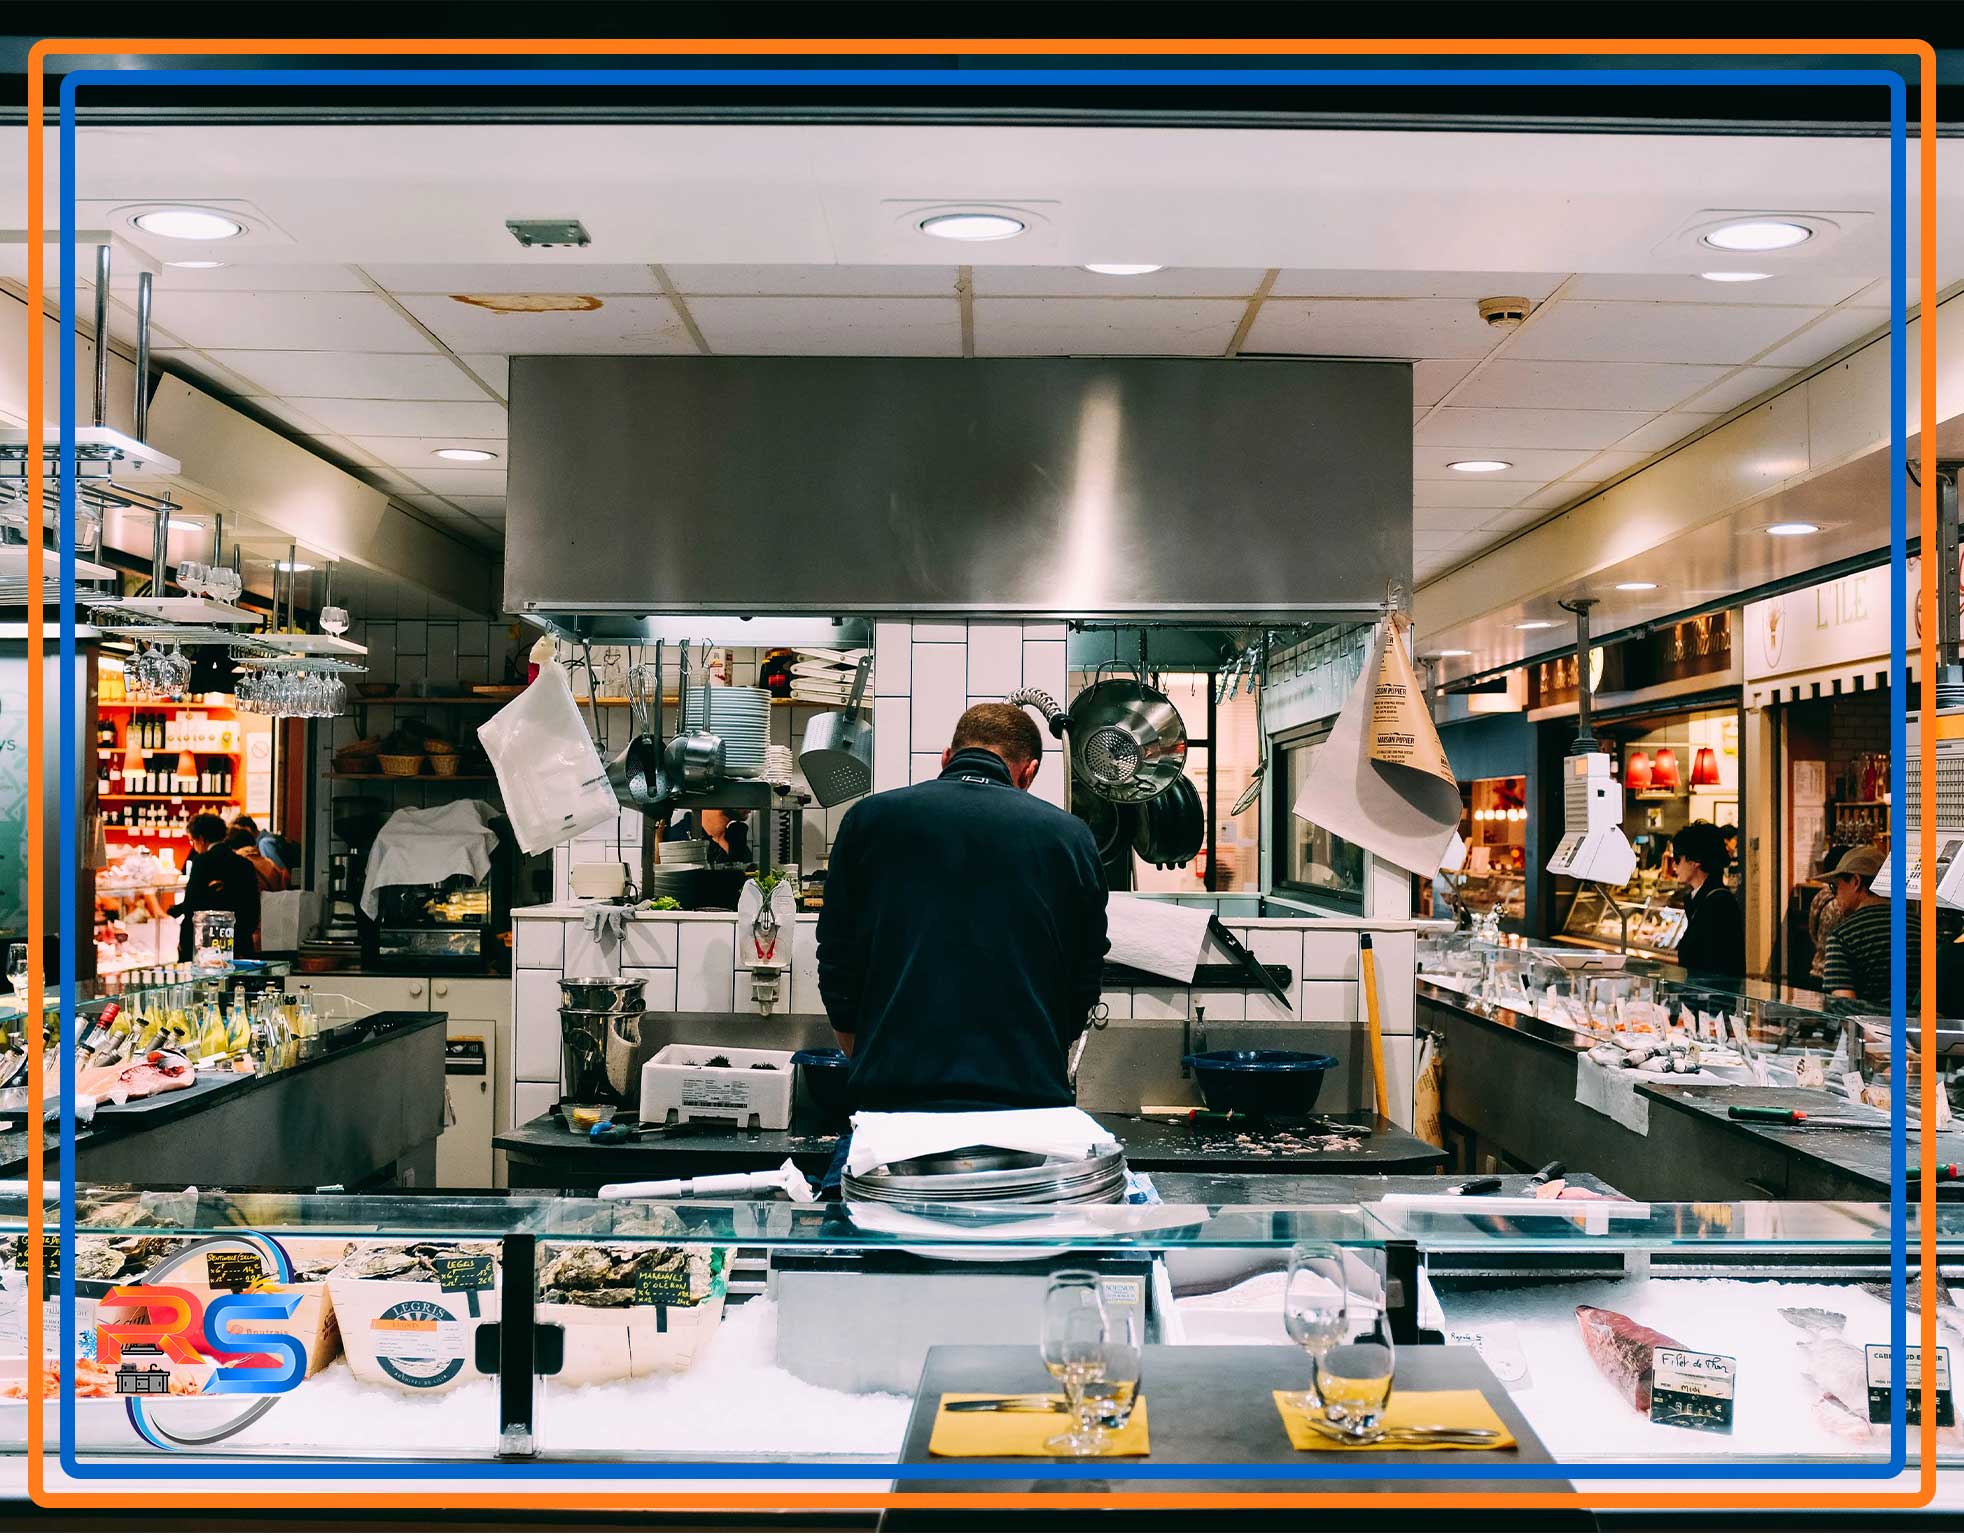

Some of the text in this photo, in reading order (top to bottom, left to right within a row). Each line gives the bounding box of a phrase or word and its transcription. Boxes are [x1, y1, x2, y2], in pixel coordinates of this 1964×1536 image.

[393, 1302, 446, 1319] LEGRIS
[1661, 1353, 1690, 1368] Filet
[1692, 1358, 1703, 1369] de
